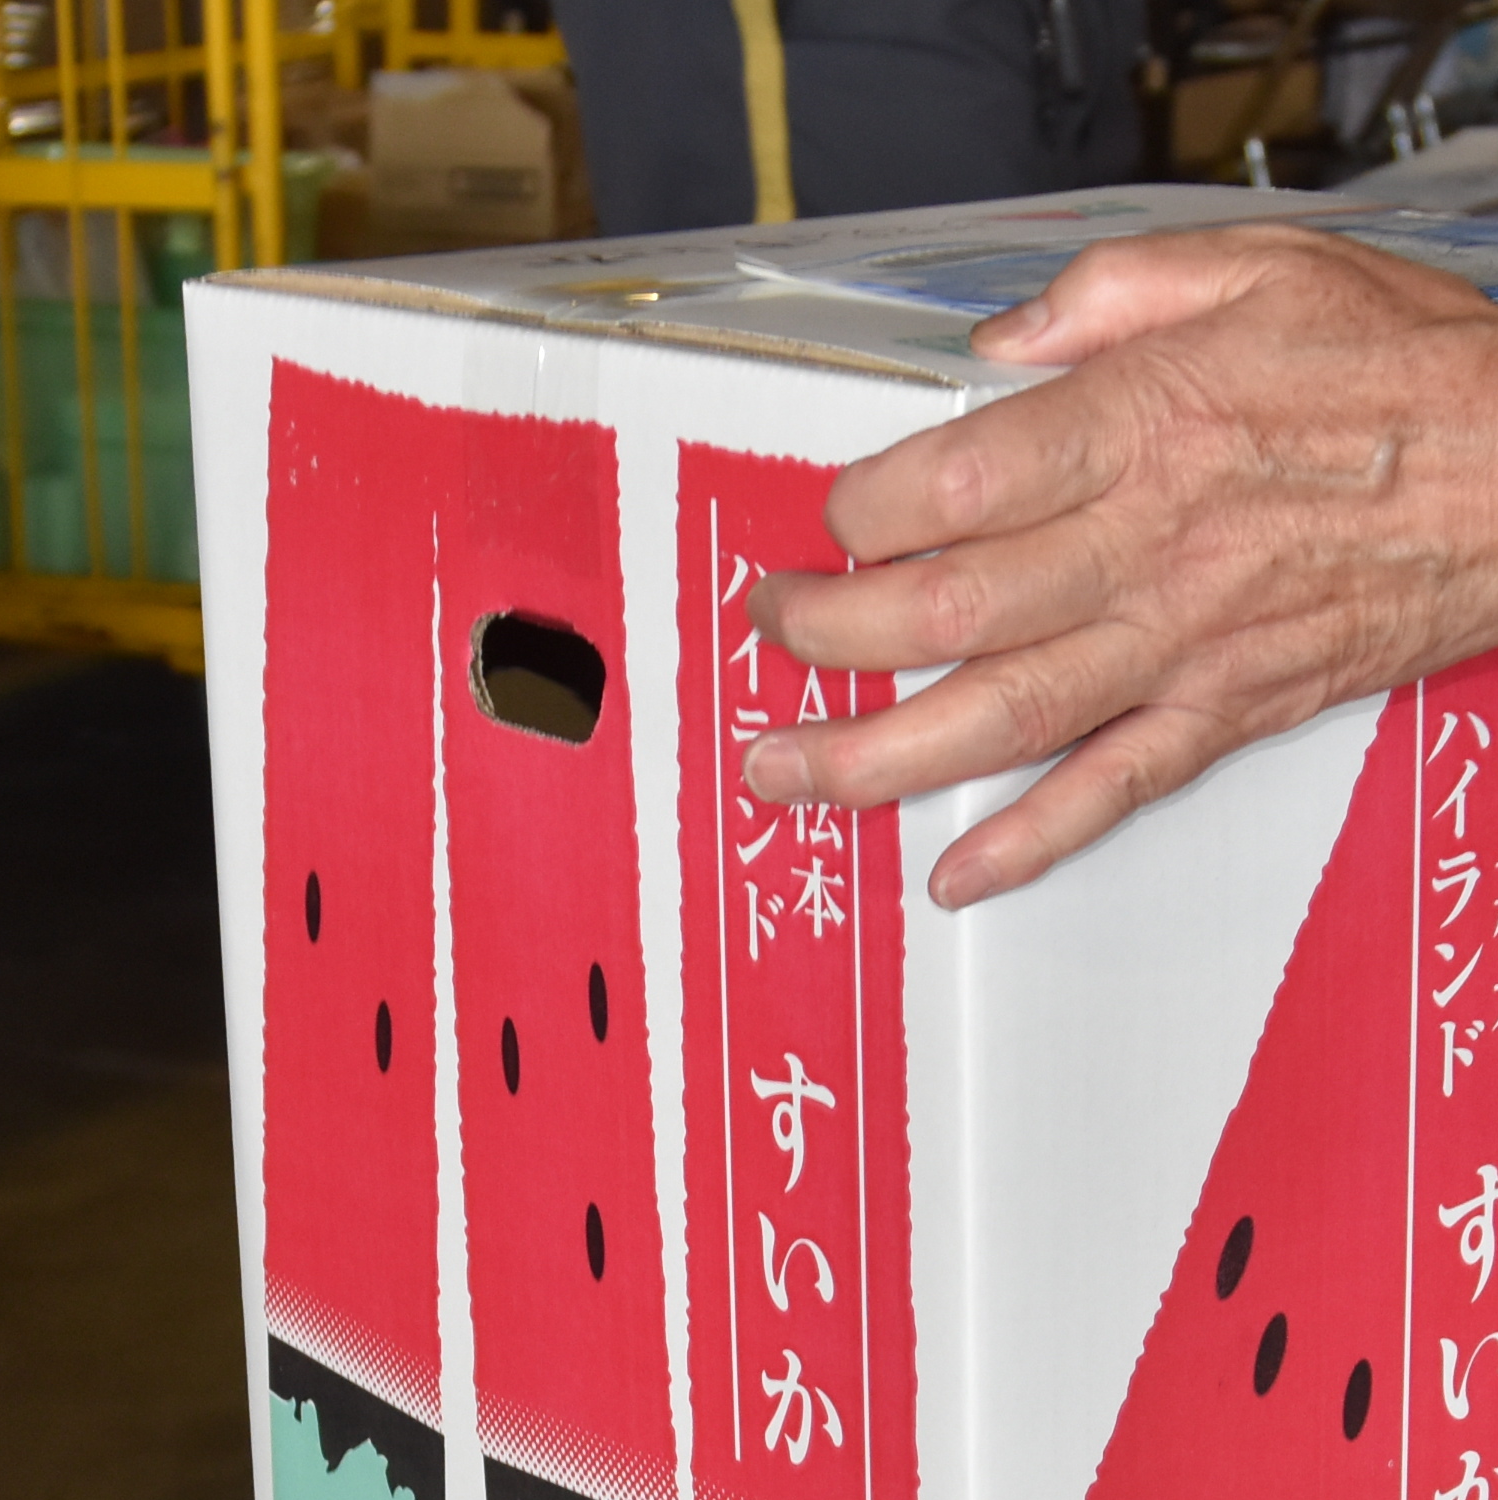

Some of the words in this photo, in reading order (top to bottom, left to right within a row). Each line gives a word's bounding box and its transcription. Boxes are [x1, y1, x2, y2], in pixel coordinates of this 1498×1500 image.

[789, 666, 846, 938] A松本
[1426, 712, 1491, 1098] ハイランド
[750, 1052, 843, 1465] すいか
